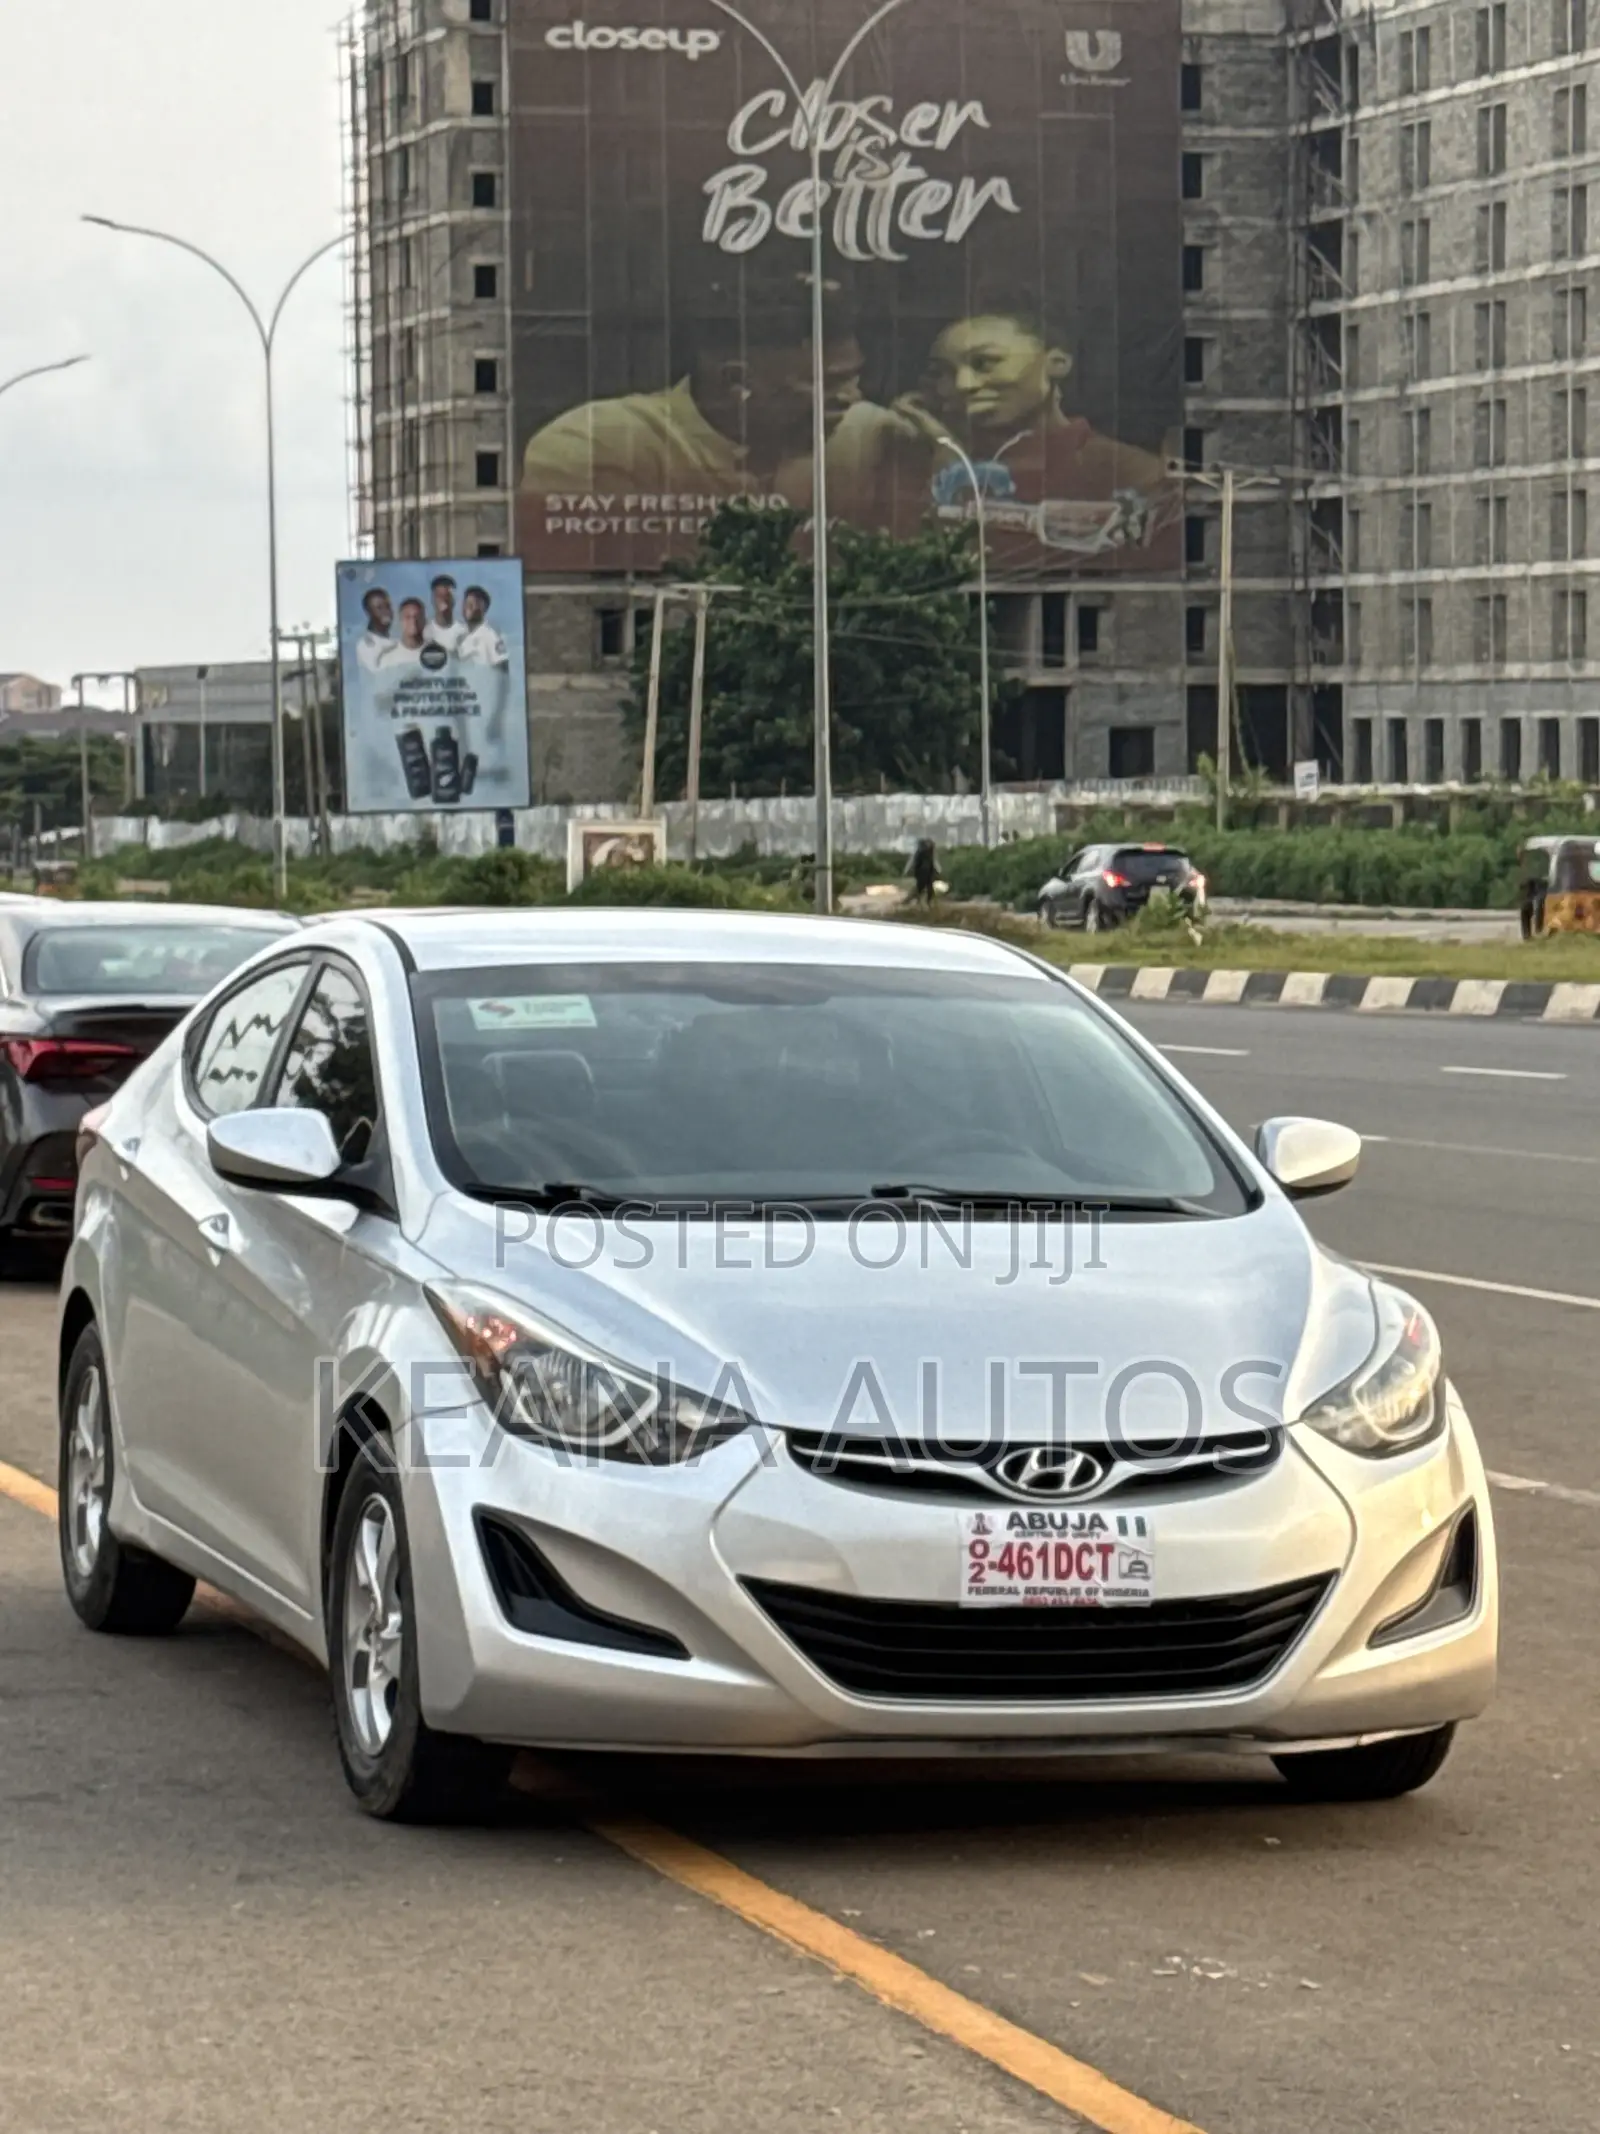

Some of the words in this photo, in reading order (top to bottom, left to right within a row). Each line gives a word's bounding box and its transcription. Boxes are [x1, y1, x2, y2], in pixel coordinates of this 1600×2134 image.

[544, 20, 720, 60] closeup
[726, 78, 991, 155] Closer
[833, 127, 893, 181] is
[702, 151, 1021, 262] Better
[545, 494, 615, 512] STAY
[623, 493, 717, 512] FRESH
[1005, 1510, 1110, 1532] ABUJA
